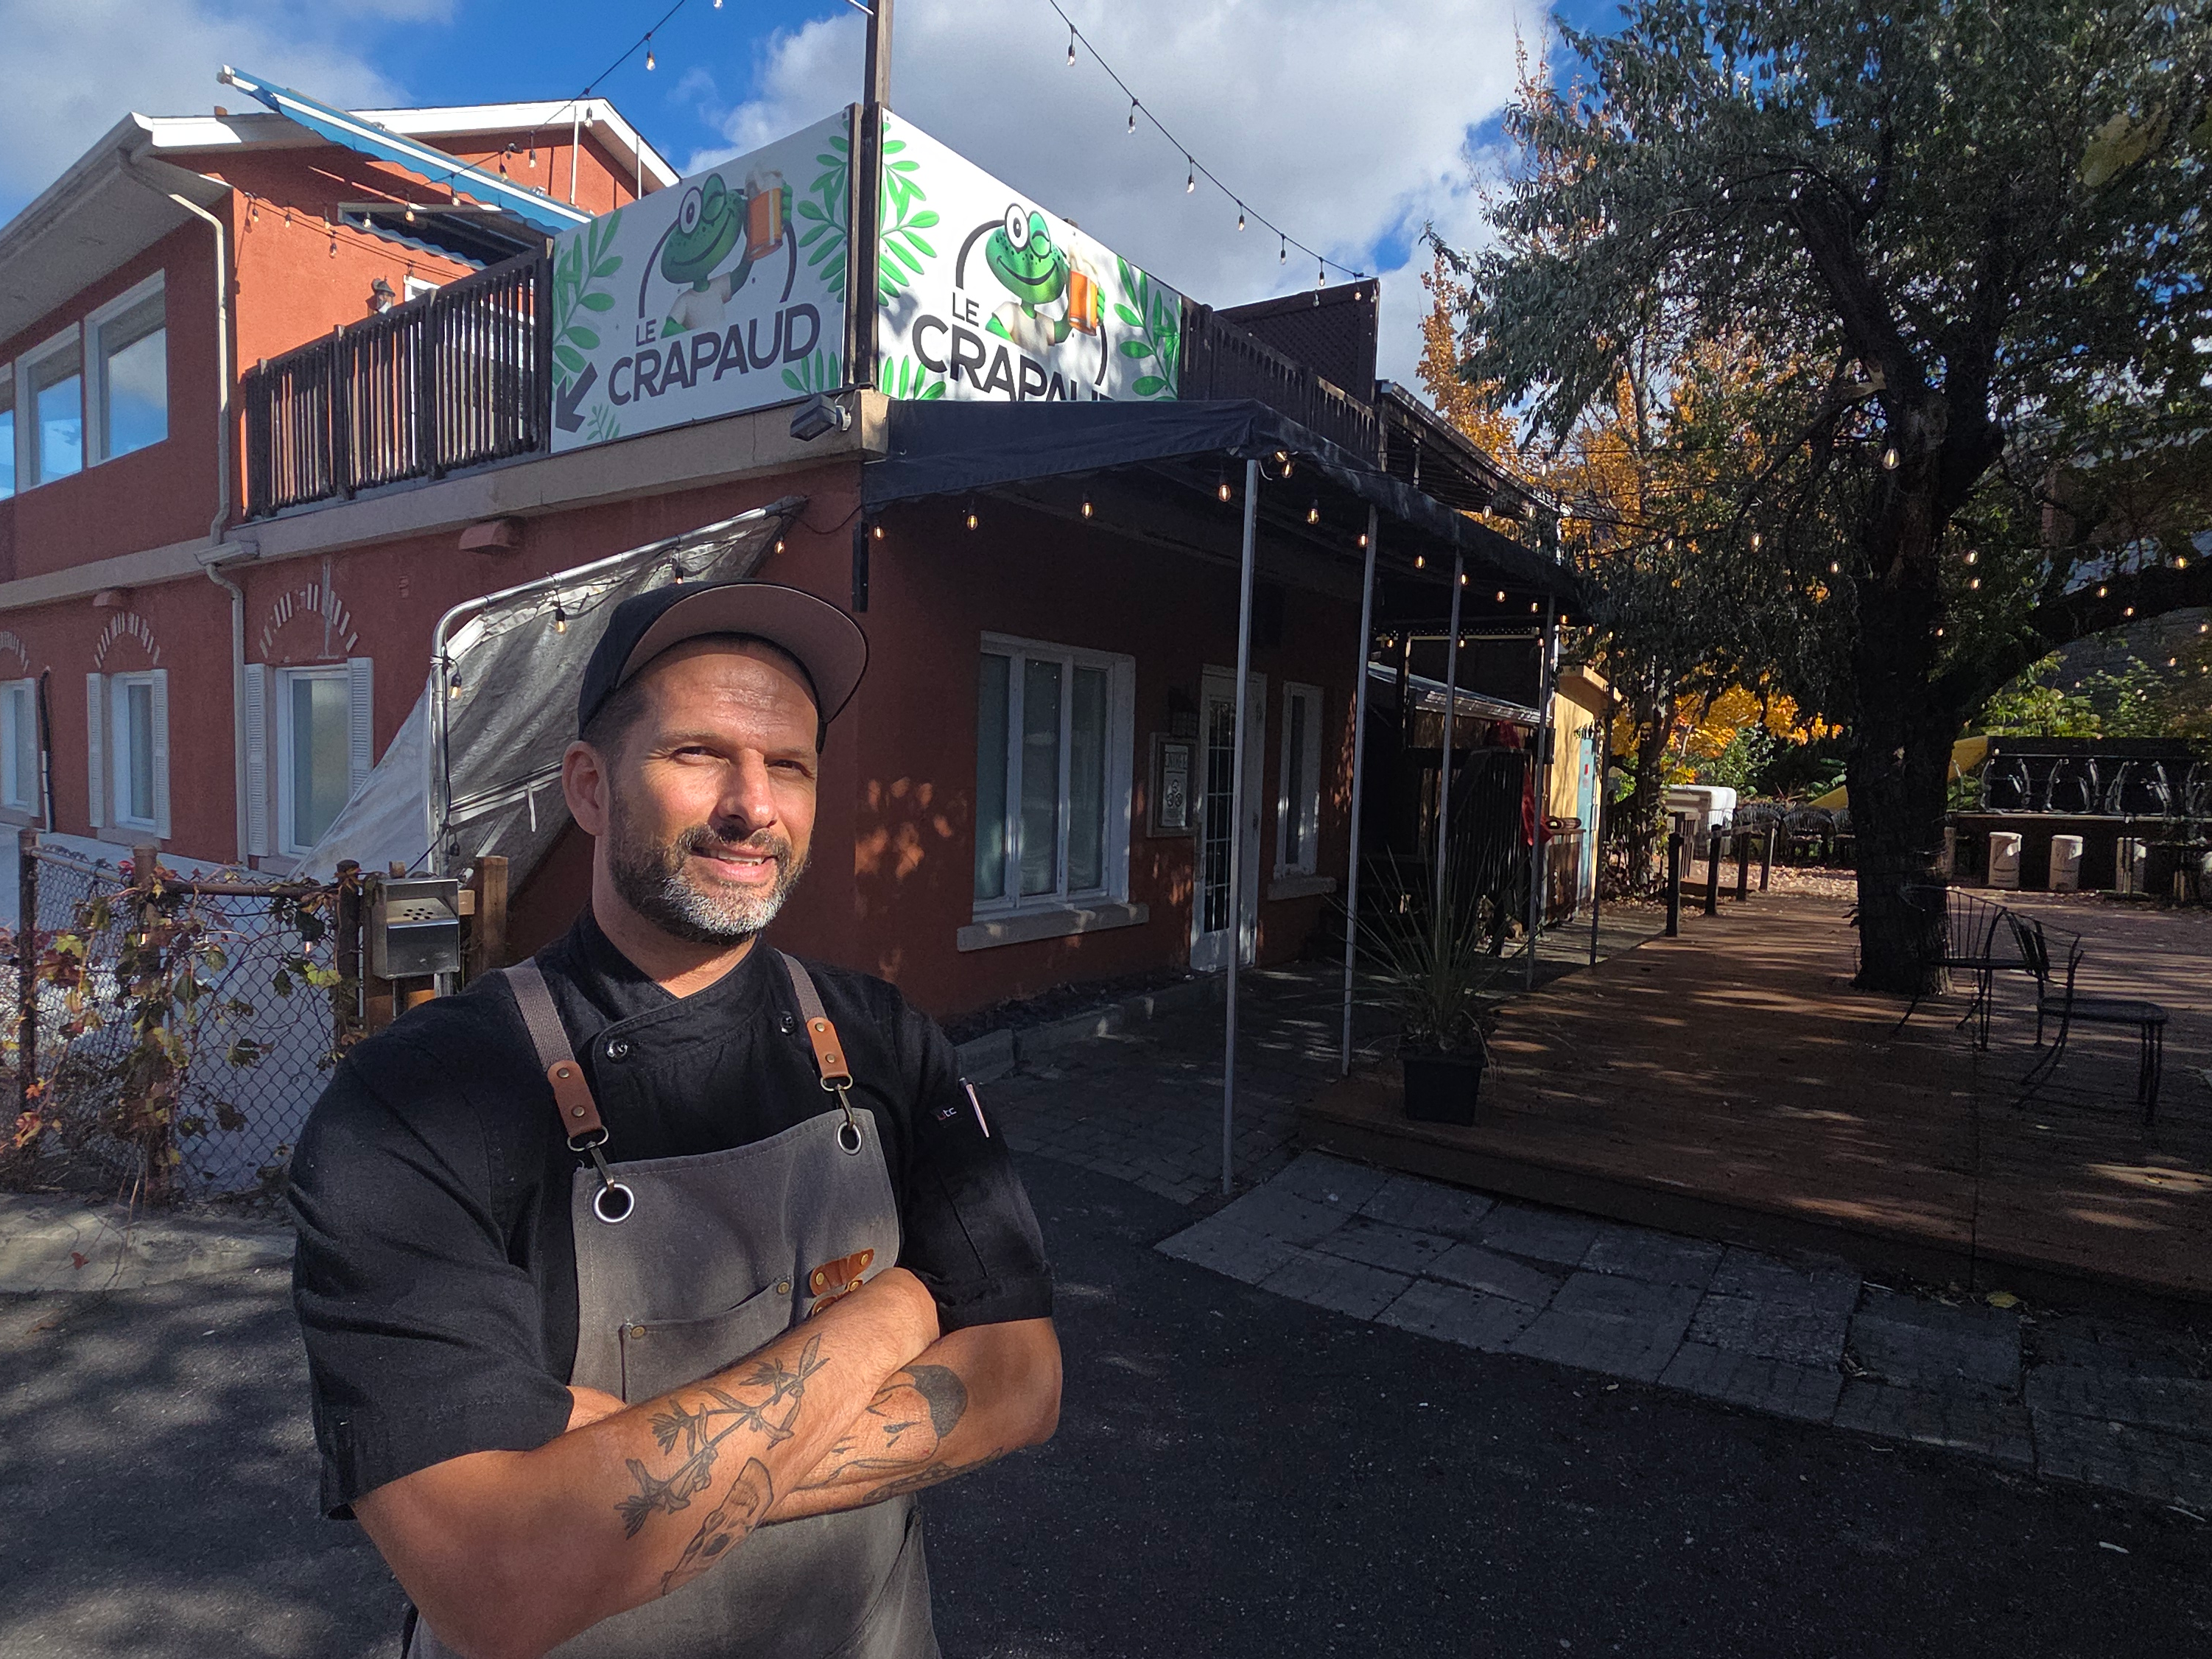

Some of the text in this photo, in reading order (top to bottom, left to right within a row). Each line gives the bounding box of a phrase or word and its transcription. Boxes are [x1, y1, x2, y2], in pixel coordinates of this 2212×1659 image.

[636, 318, 656, 345] LE
[952, 292, 979, 326] LE
[608, 304, 821, 406] CRAPAUD
[912, 315, 1114, 401] CRAPA
